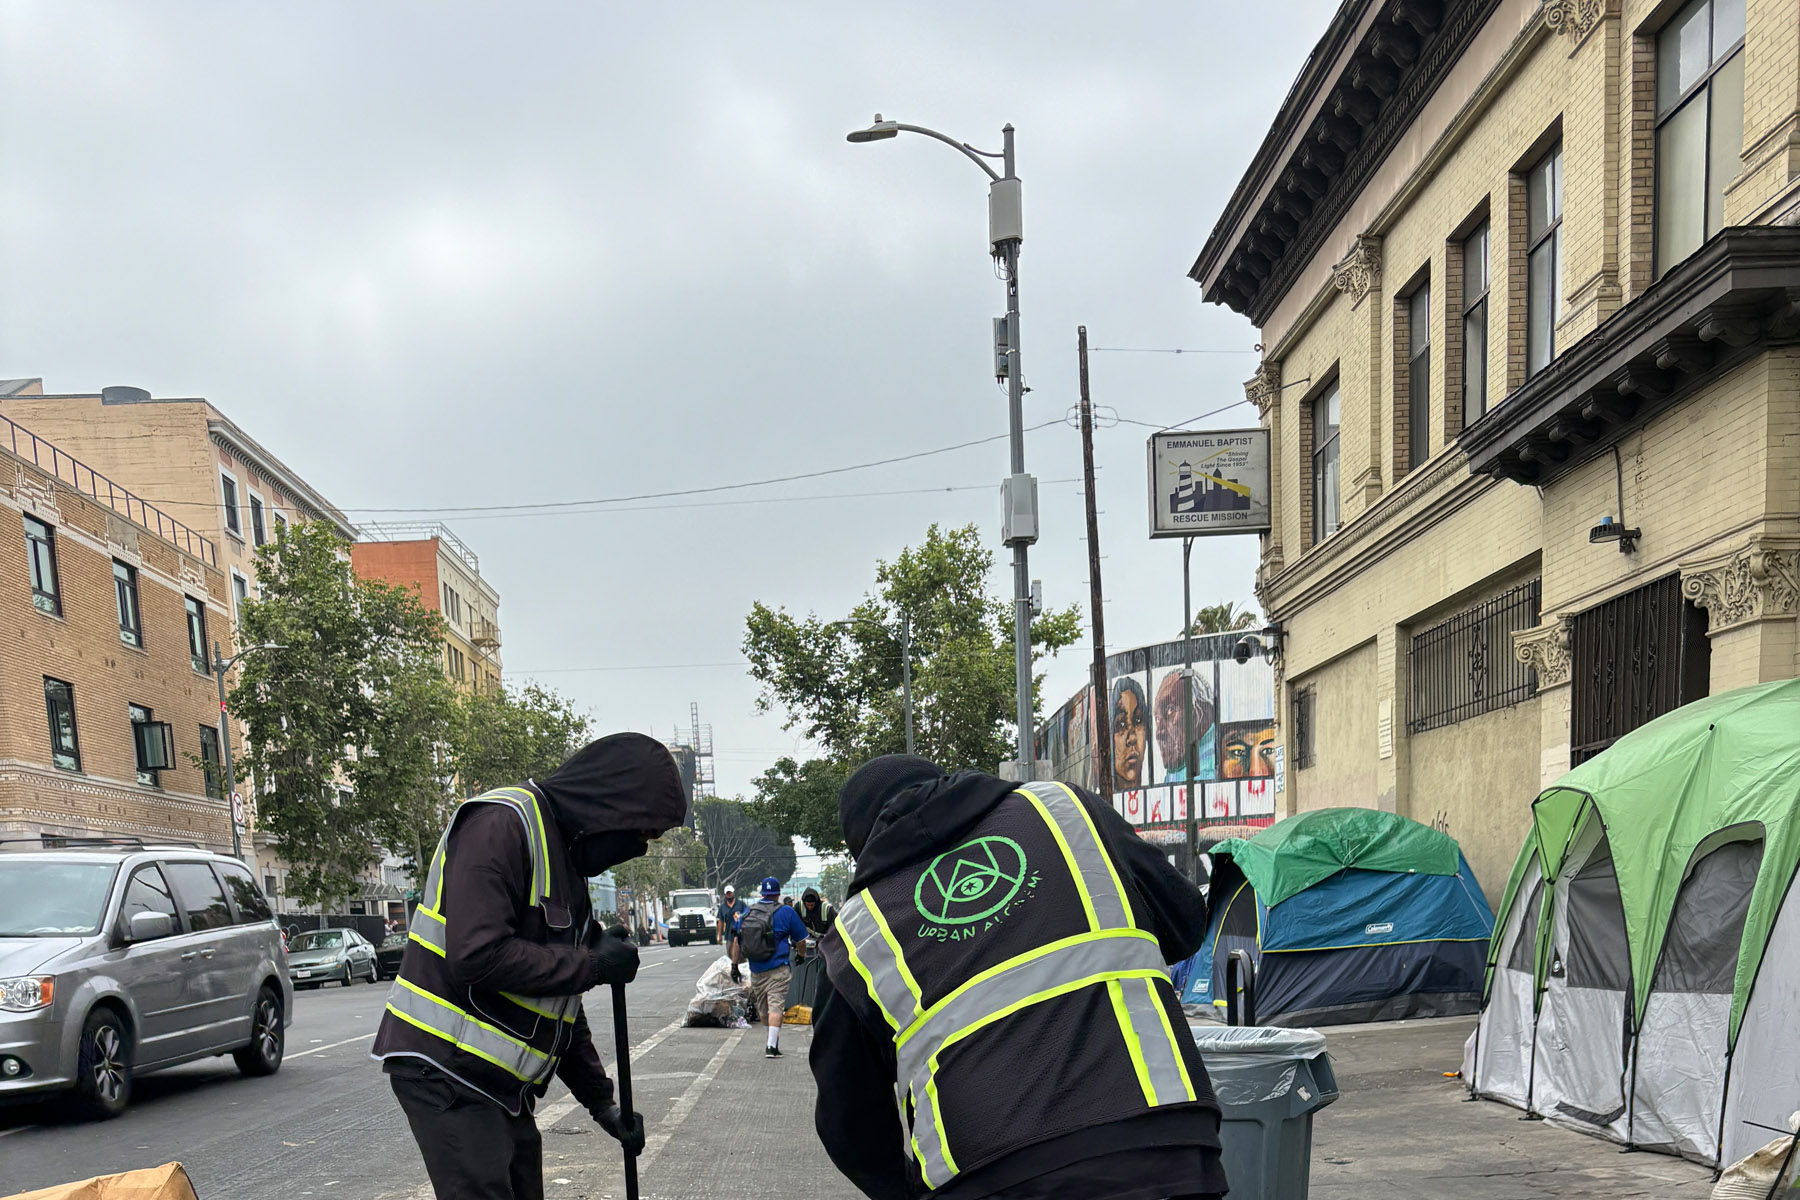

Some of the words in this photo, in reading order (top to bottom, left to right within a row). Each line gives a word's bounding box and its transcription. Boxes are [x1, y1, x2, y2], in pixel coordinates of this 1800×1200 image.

[1167, 439, 1215, 449] EMMANUEL
[1217, 437, 1253, 446] BAPTIST
[1173, 514, 1209, 523] RESCUE
[1211, 512, 1248, 521] MISSION
[917, 923, 976, 943] URBAN
